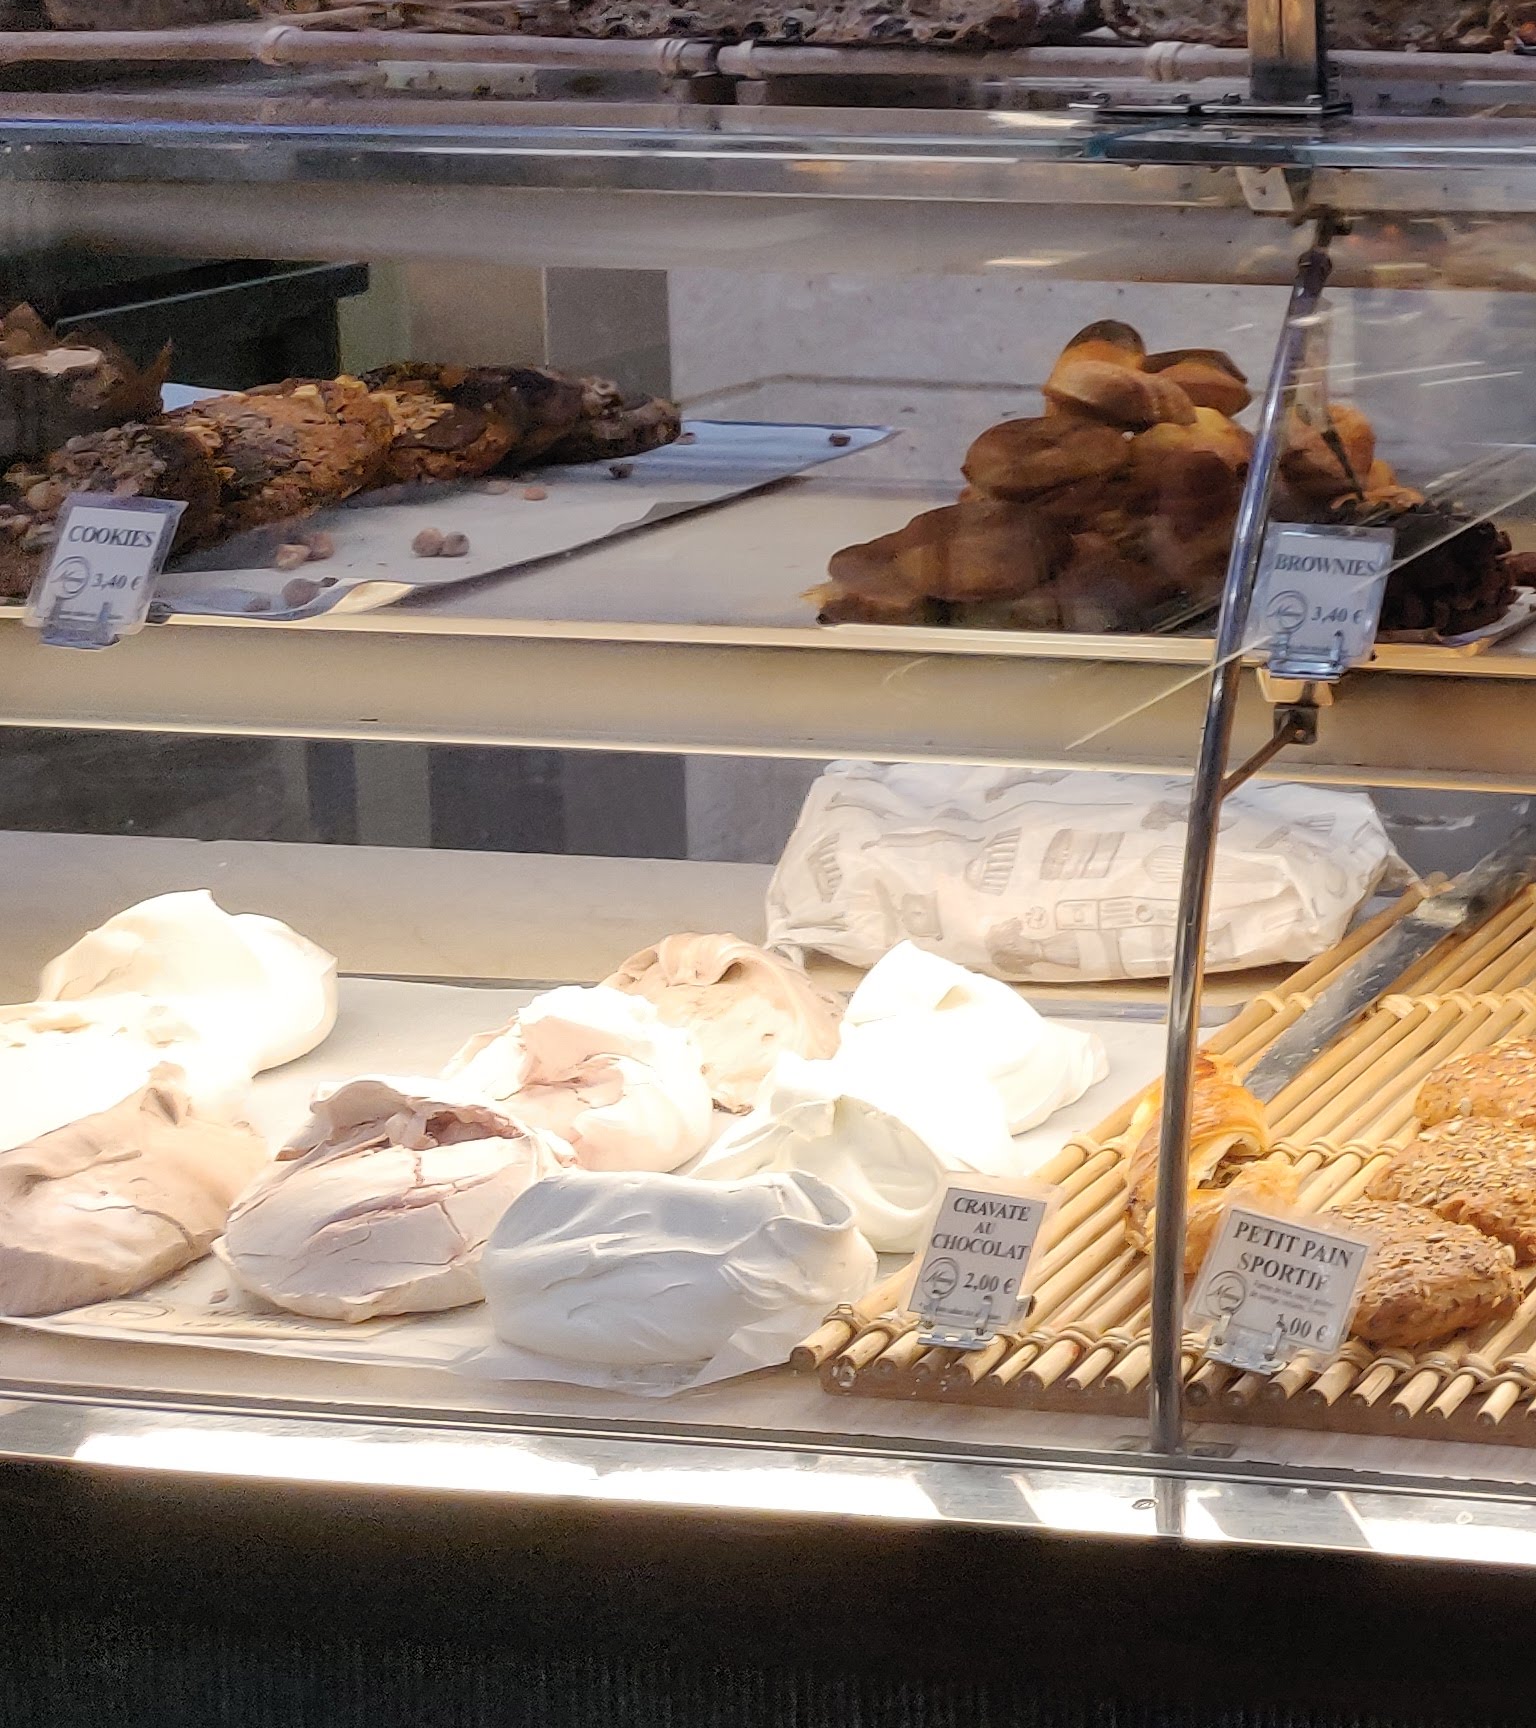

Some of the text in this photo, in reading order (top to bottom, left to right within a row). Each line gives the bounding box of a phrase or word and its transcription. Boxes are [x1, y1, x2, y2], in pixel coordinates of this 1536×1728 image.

[68, 525, 156, 548] COOKIES
[1273, 553, 1377, 577] BROWNIES
[953, 1196, 1032, 1222] CRAVATE
[973, 1221, 998, 1235] AU
[931, 1233, 1030, 1261] CHOCOLAT
[1232, 1221, 1354, 1270] PETIT PAIN
[963, 1272, 1000, 1293] 2,00
[1003, 1277, 1016, 1294] €
[1237, 1251, 1331, 1292] SPORTIF
